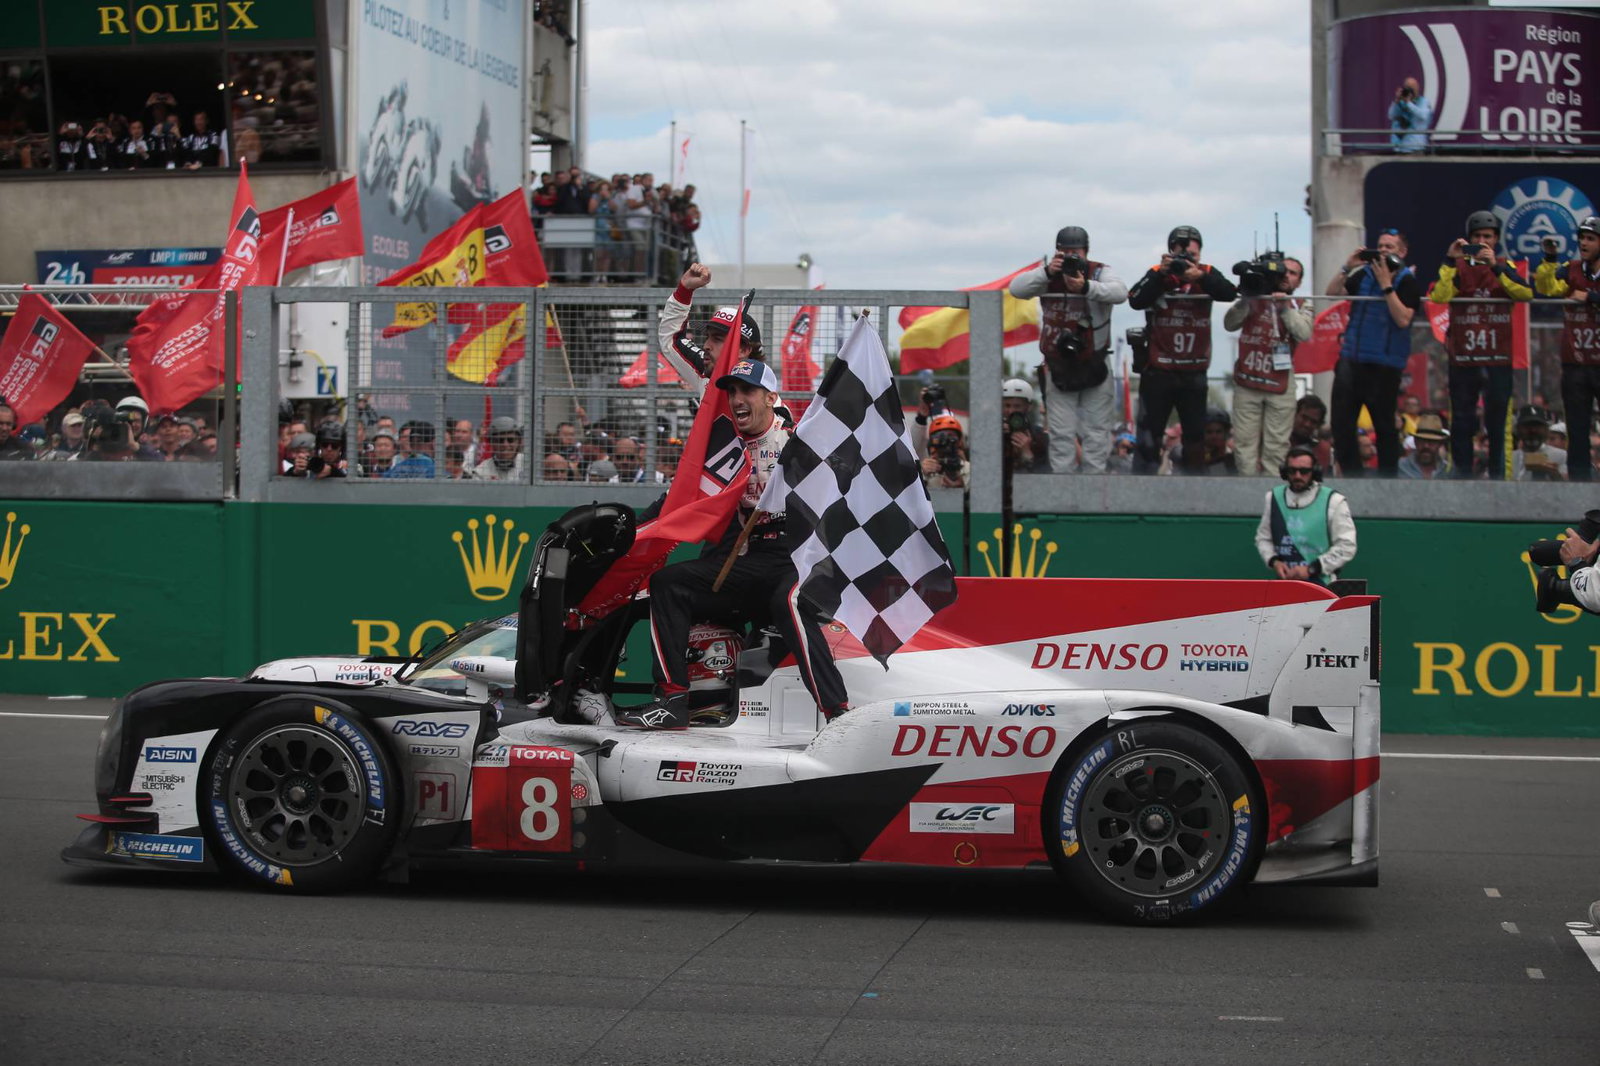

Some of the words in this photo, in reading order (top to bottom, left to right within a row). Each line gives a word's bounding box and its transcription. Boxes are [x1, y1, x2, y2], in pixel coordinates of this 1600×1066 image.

[99, 1, 258, 35] ROLEX
[1526, 24, 1581, 46] Région
[1493, 49, 1582, 87] PAYS
[1546, 89, 1565, 105] de
[1569, 90, 1582, 106] la
[1480, 106, 1582, 144] LOIRE
[151, 251, 176, 264] LMP1
[178, 251, 208, 262] HYBRID
[44, 262, 86, 285] 24h
[1173, 332, 1196, 353] 97
[1465, 328, 1497, 351] 341
[1244, 350, 1273, 374] 466
[319, 368, 336, 394] 7
[1030, 642, 1169, 671] DENSO
[1181, 644, 1248, 658] TOYOTA
[452, 660, 475, 672] Mobil
[708, 658, 729, 666] Arai
[1180, 659, 1249, 672] HYBRID
[1304, 653, 1360, 670] JTEKT
[335, 673, 380, 681] HYBRD
[384, 666, 393, 677] 8
[392, 720, 470, 738] RAYS
[891, 724, 1057, 758] DENSO
[1118, 730, 1145, 753] RL
[149, 749, 193, 761] AISIN
[338, 721, 384, 800] MICHELIN
[514, 748, 571, 761] TOTAL
[657, 768, 694, 782] GR
[698, 770, 737, 778] GAZOO
[699, 762, 742, 771] TOYOTA
[142, 782, 175, 791] ELECTRIC
[146, 774, 185, 784] MITSUBISHI
[696, 776, 736, 786] Racing
[1062, 746, 1107, 826] MICHELIN
[419, 779, 450, 813] P1
[520, 777, 560, 841] 8
[935, 805, 1001, 822] WEC
[126, 840, 194, 854] MICHELIN
[213, 804, 266, 875] MICHELIN
[1197, 830, 1248, 904] MICHELIN
